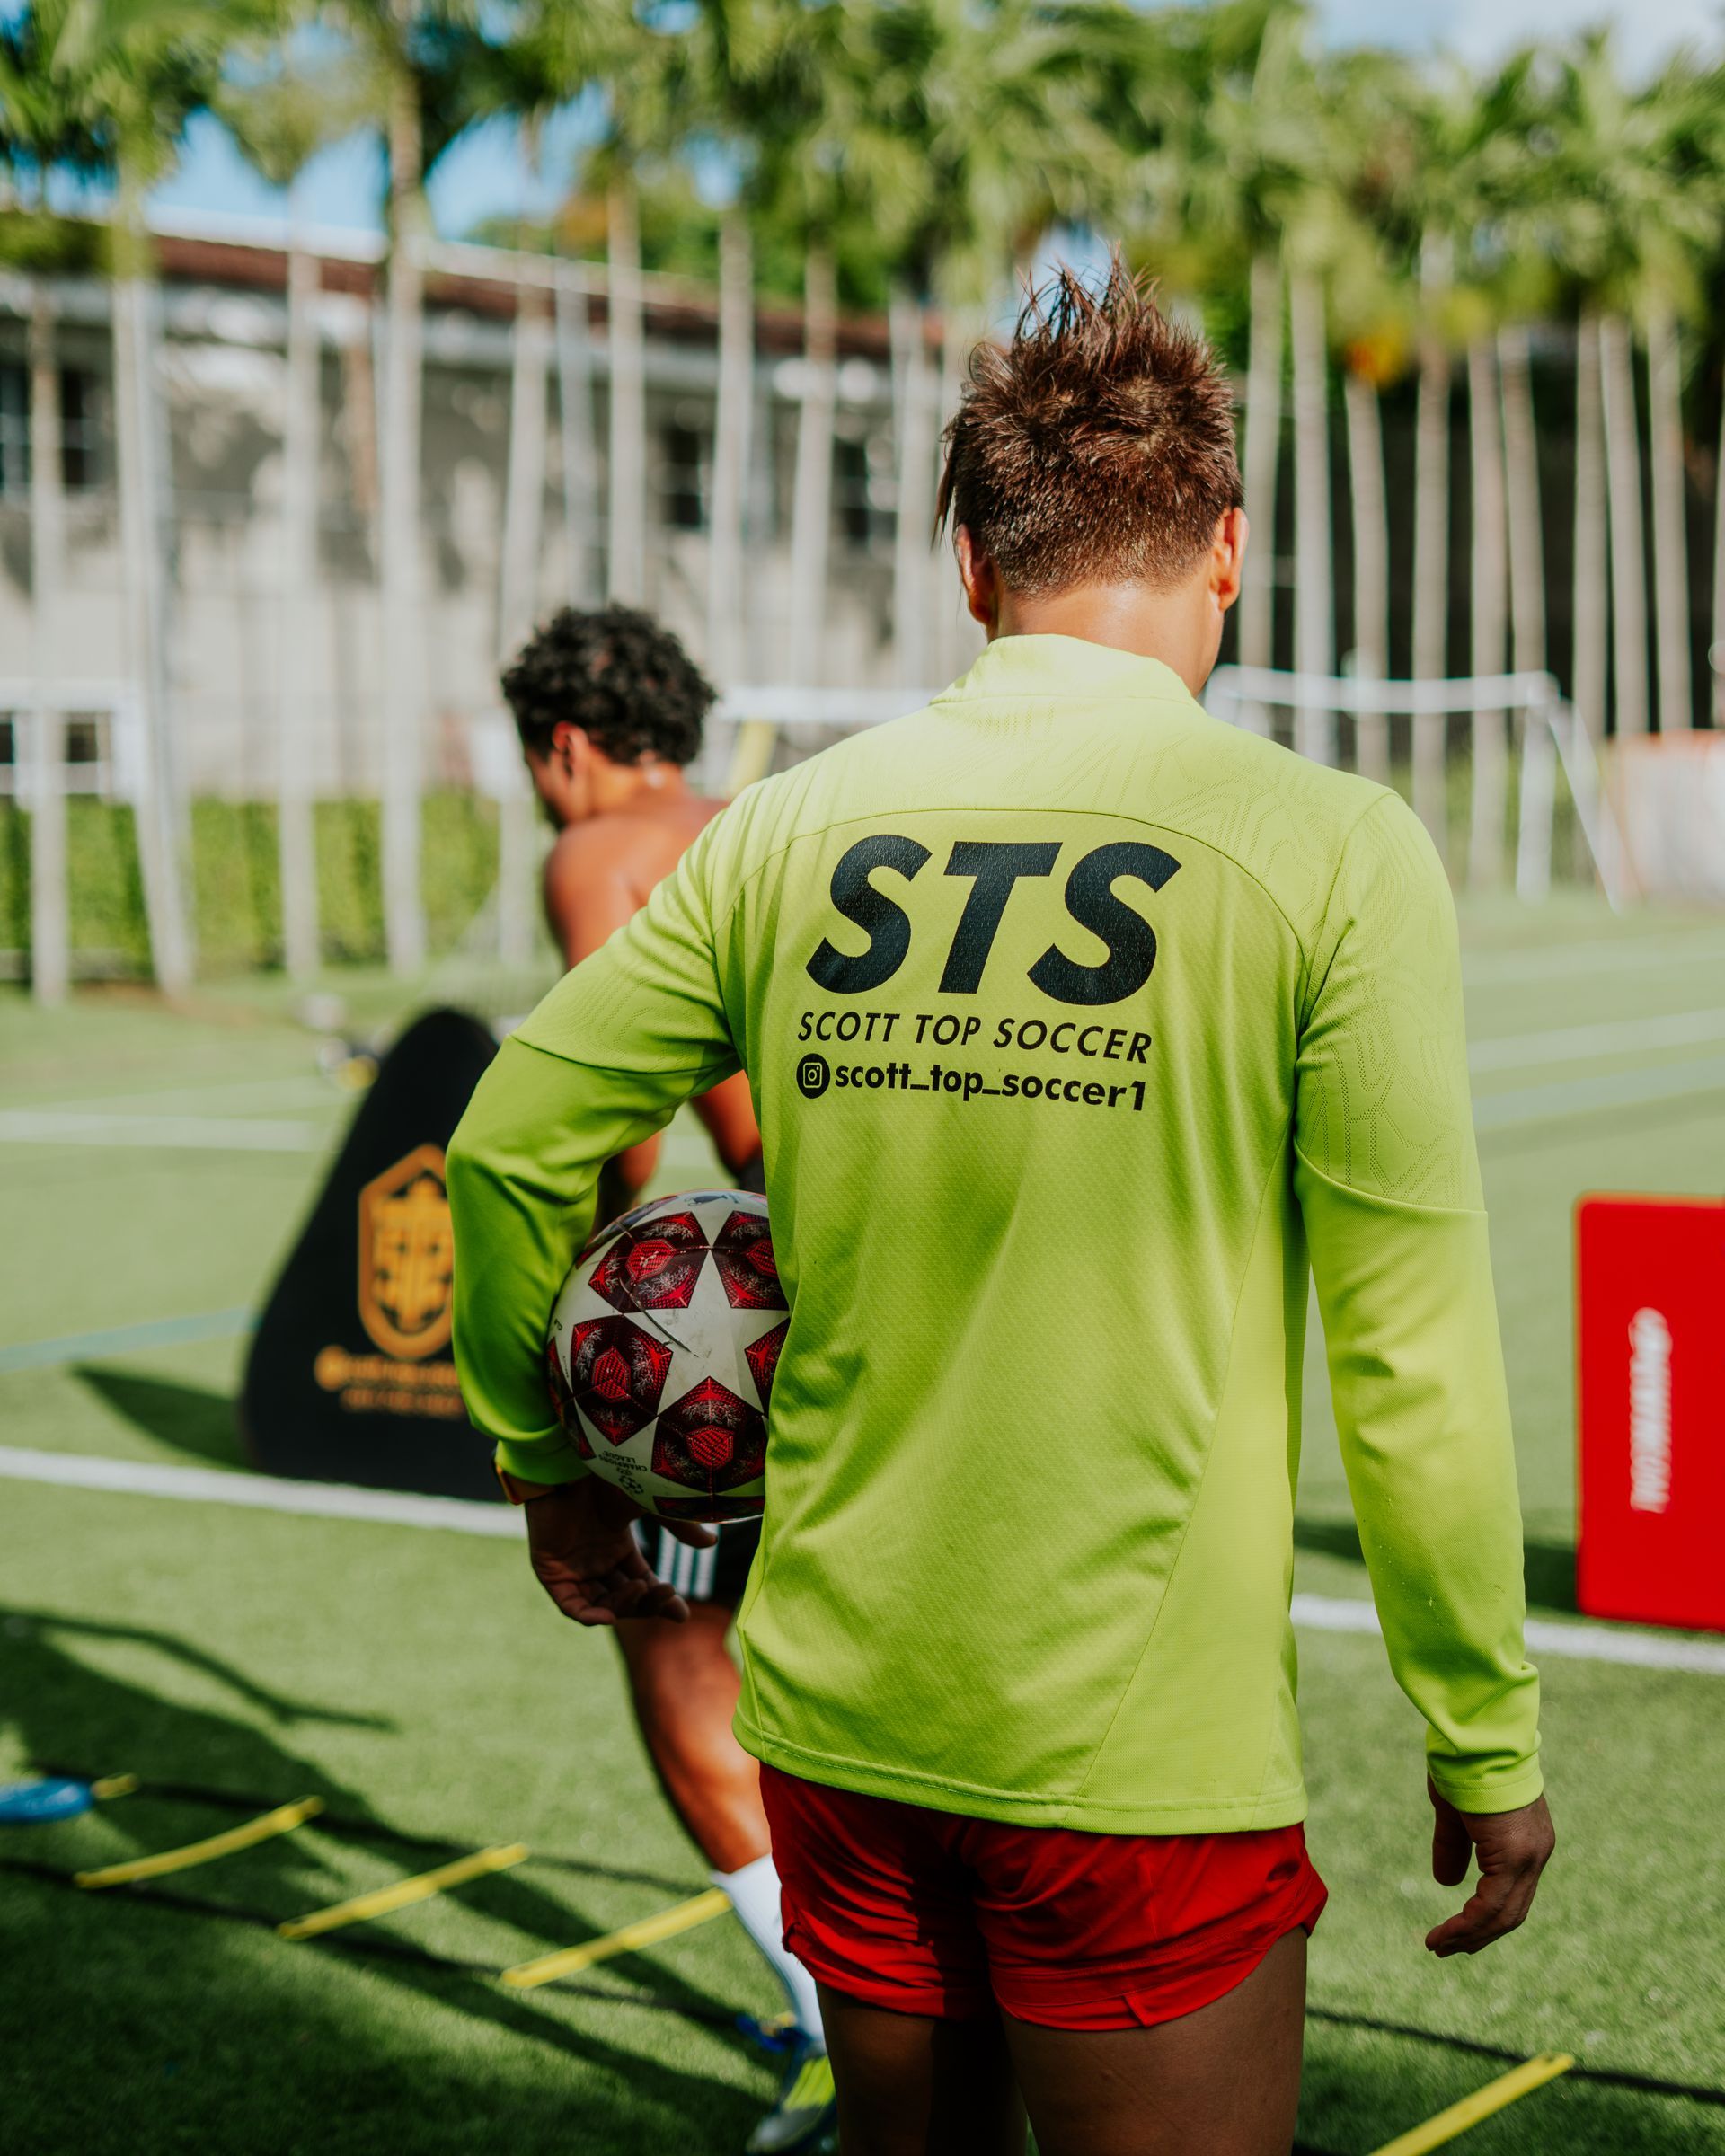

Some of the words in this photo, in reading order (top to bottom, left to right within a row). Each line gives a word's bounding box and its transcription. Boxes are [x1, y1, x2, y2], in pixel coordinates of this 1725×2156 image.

[805, 834, 1182, 1006] STS
[797, 1011, 901, 1043] SCOTT
[916, 1014, 982, 1046] TOP
[992, 1018, 1152, 1064] SOCCER
[835, 1062, 1146, 1111] scott_top_soccer1
